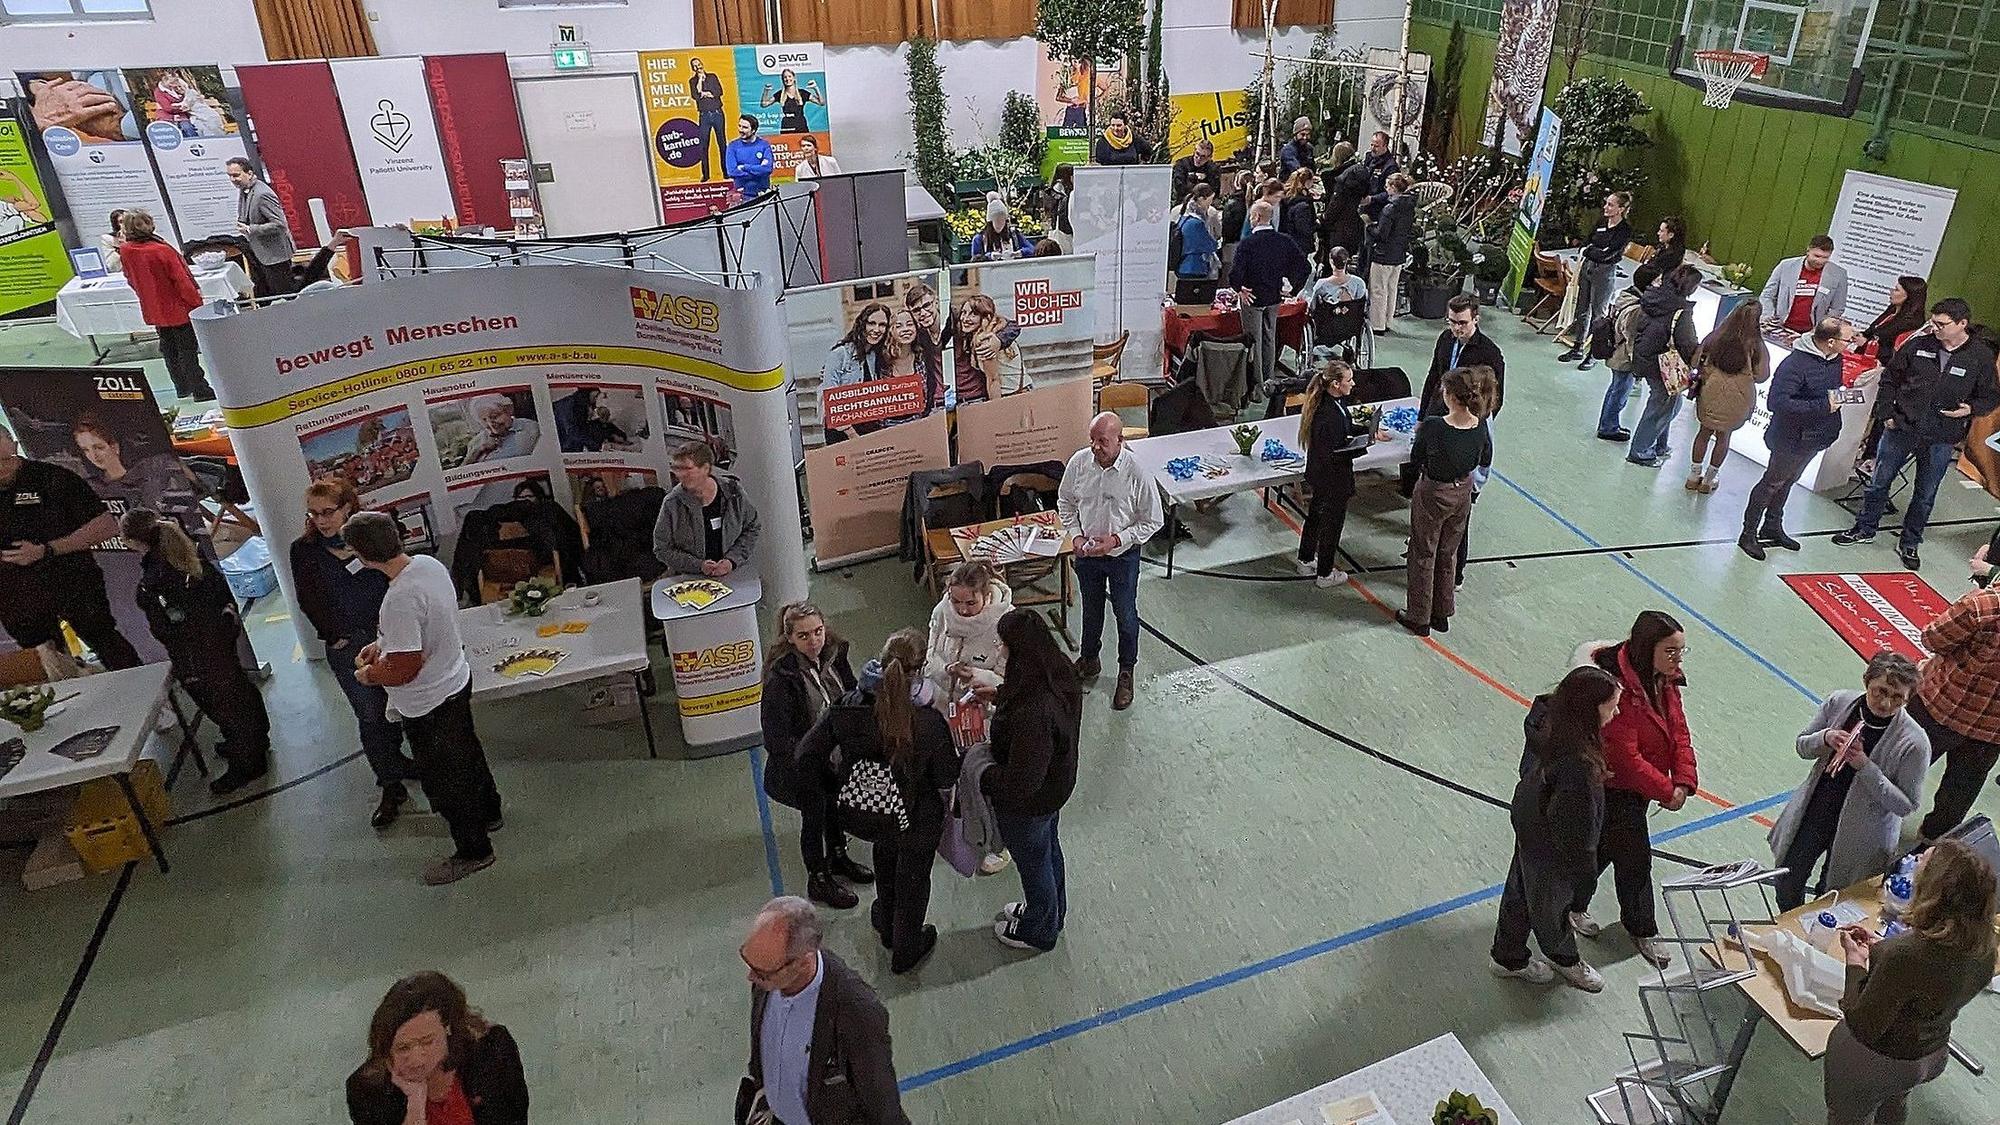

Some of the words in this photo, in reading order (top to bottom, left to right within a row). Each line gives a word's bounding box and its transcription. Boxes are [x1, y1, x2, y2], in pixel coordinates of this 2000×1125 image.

[560, 29, 575, 42] M
[647, 58, 676, 70] HIER
[778, 54, 808, 62] SWB
[649, 72, 667, 83] IST
[650, 83, 684, 96] MEIN
[653, 96, 692, 108] PLATZ
[661, 131, 683, 142] swb-
[664, 137, 700, 151] karriere
[668, 151, 682, 161] .de
[397, 164, 432, 172] University
[1016, 281, 1048, 295] WIR
[1017, 293, 1080, 311] SUCHEN
[655, 293, 719, 333] ASB
[1017, 310, 1061, 326] DICH!
[275, 335, 374, 375] bewegt
[386, 315, 518, 346] Menschen
[93, 377, 142, 391] ZOLL
[288, 373, 392, 411] Service-Hotline:
[396, 365, 427, 380] 0800
[440, 361, 455, 372] 65
[459, 358, 473, 369] 22
[479, 355, 497, 366] 110
[516, 351, 597, 363] www.a-s-b.eu
[422, 380, 476, 397] Hausnotruf
[829, 384, 889, 401] AUSBILDUNG
[830, 392, 919, 414] RECHTSANWALTS-
[295, 403, 370, 432] Rettungswesen
[830, 402, 920, 424] FACHANGESTELLTEN
[1816, 580, 1858, 616] Schön
[1848, 579, 1882, 605] TAGEN
[1878, 602, 1909, 627] UND
[697, 640, 755, 669] ASB
